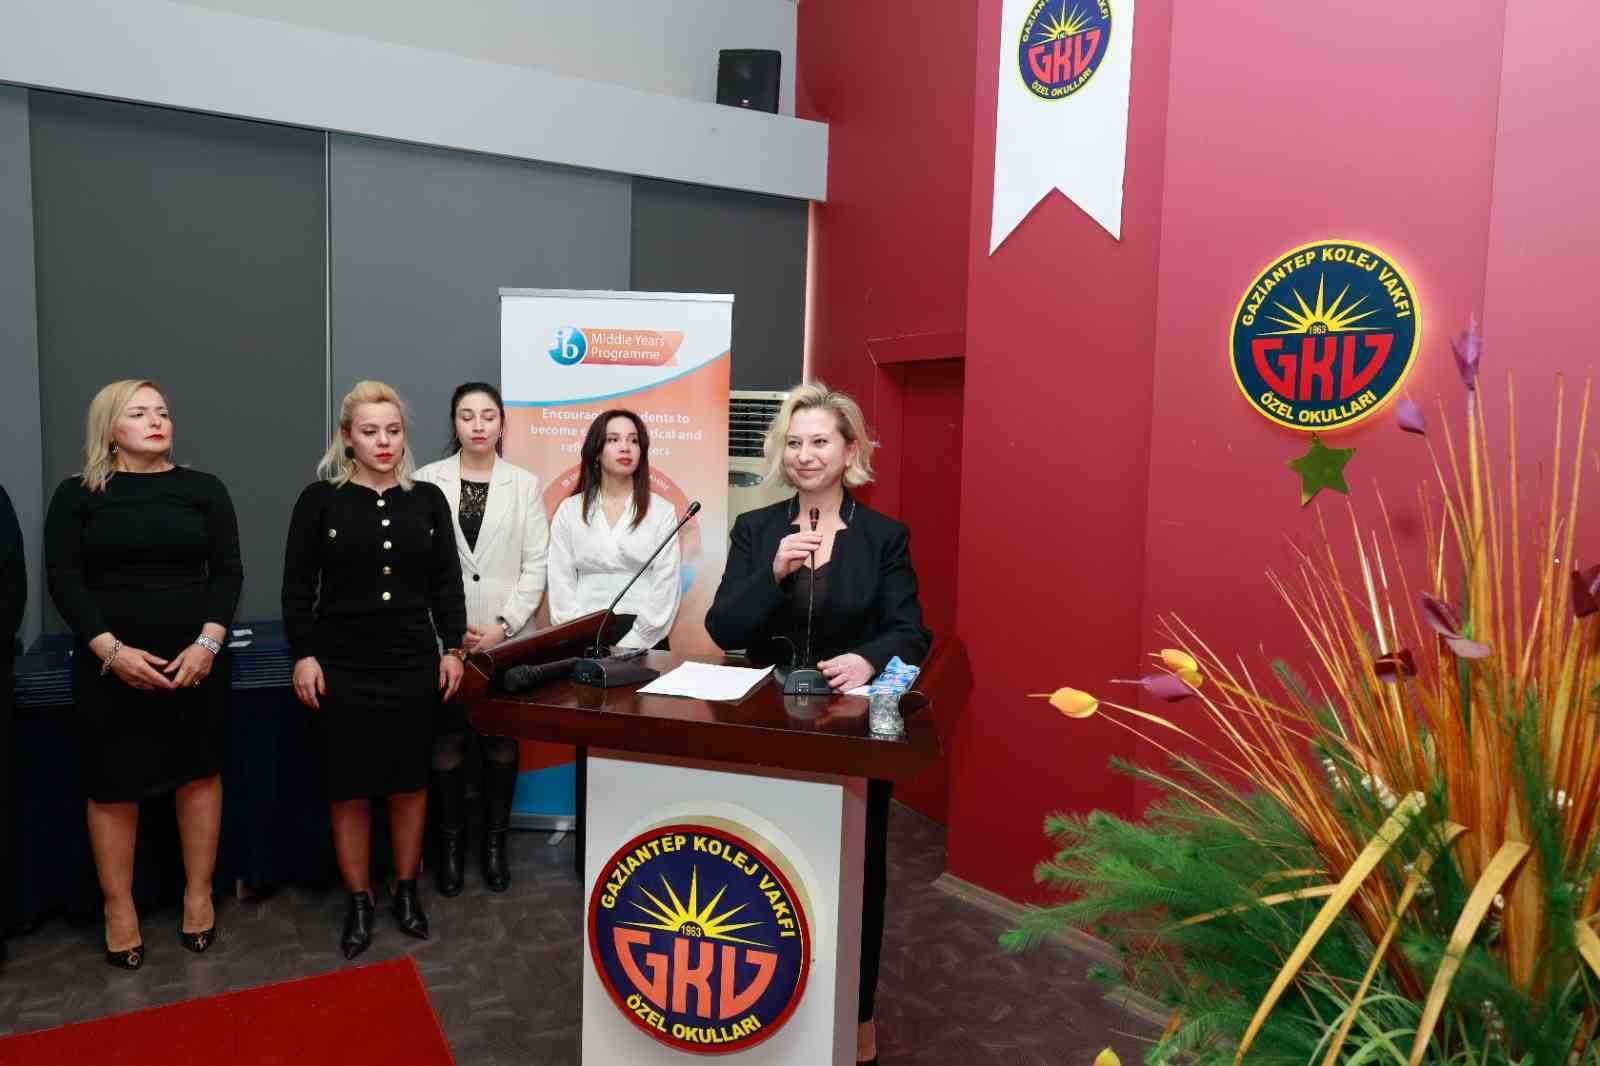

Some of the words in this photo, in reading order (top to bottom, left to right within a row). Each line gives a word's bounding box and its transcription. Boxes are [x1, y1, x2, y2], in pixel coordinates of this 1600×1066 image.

[1028, 29, 1101, 84] GKV
[1031, 79, 1049, 96] ÖZEL
[1051, 68, 1093, 96] OKULLARI
[1242, 250, 1317, 326] GAZİANTEP
[1322, 247, 1379, 272] KOLEJ
[1377, 267, 1411, 318] VAKFI
[591, 333, 633, 345] Middle
[635, 334, 665, 347] Years
[1308, 324, 1327, 335] 1963
[591, 347, 661, 361] Programme
[1251, 333, 1395, 402] GKV
[677, 413, 690, 424] to
[1260, 390, 1295, 420] ÖZEL
[1299, 390, 1378, 423] OKULLARI
[530, 423, 577, 436] become
[678, 429, 702, 441] and
[601, 834, 687, 909] GAZİANTEP
[694, 836, 759, 876] KOLEJ
[759, 875, 796, 937] VAKFI
[681, 924, 702, 938] 1963
[613, 926, 778, 1020] GKV
[627, 993, 668, 1032] ÖZEL
[672, 1014, 762, 1043] OKULLARI
